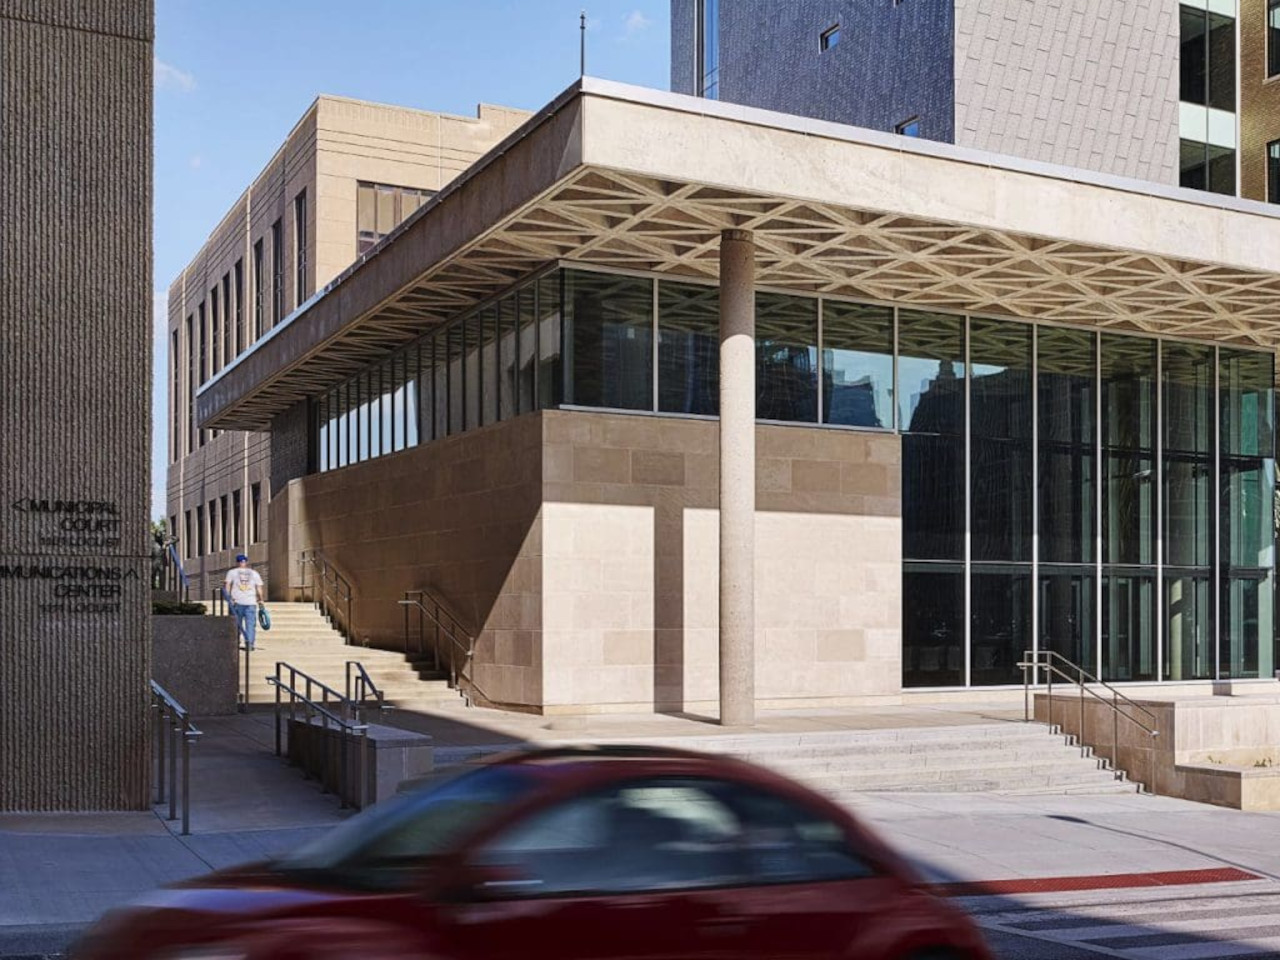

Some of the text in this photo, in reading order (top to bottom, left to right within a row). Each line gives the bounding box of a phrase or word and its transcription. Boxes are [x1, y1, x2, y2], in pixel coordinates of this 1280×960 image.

[30, 499, 121, 514] MUNICIPAL
[60, 518, 121, 532] COURT
[55, 583, 121, 597] CENTER
